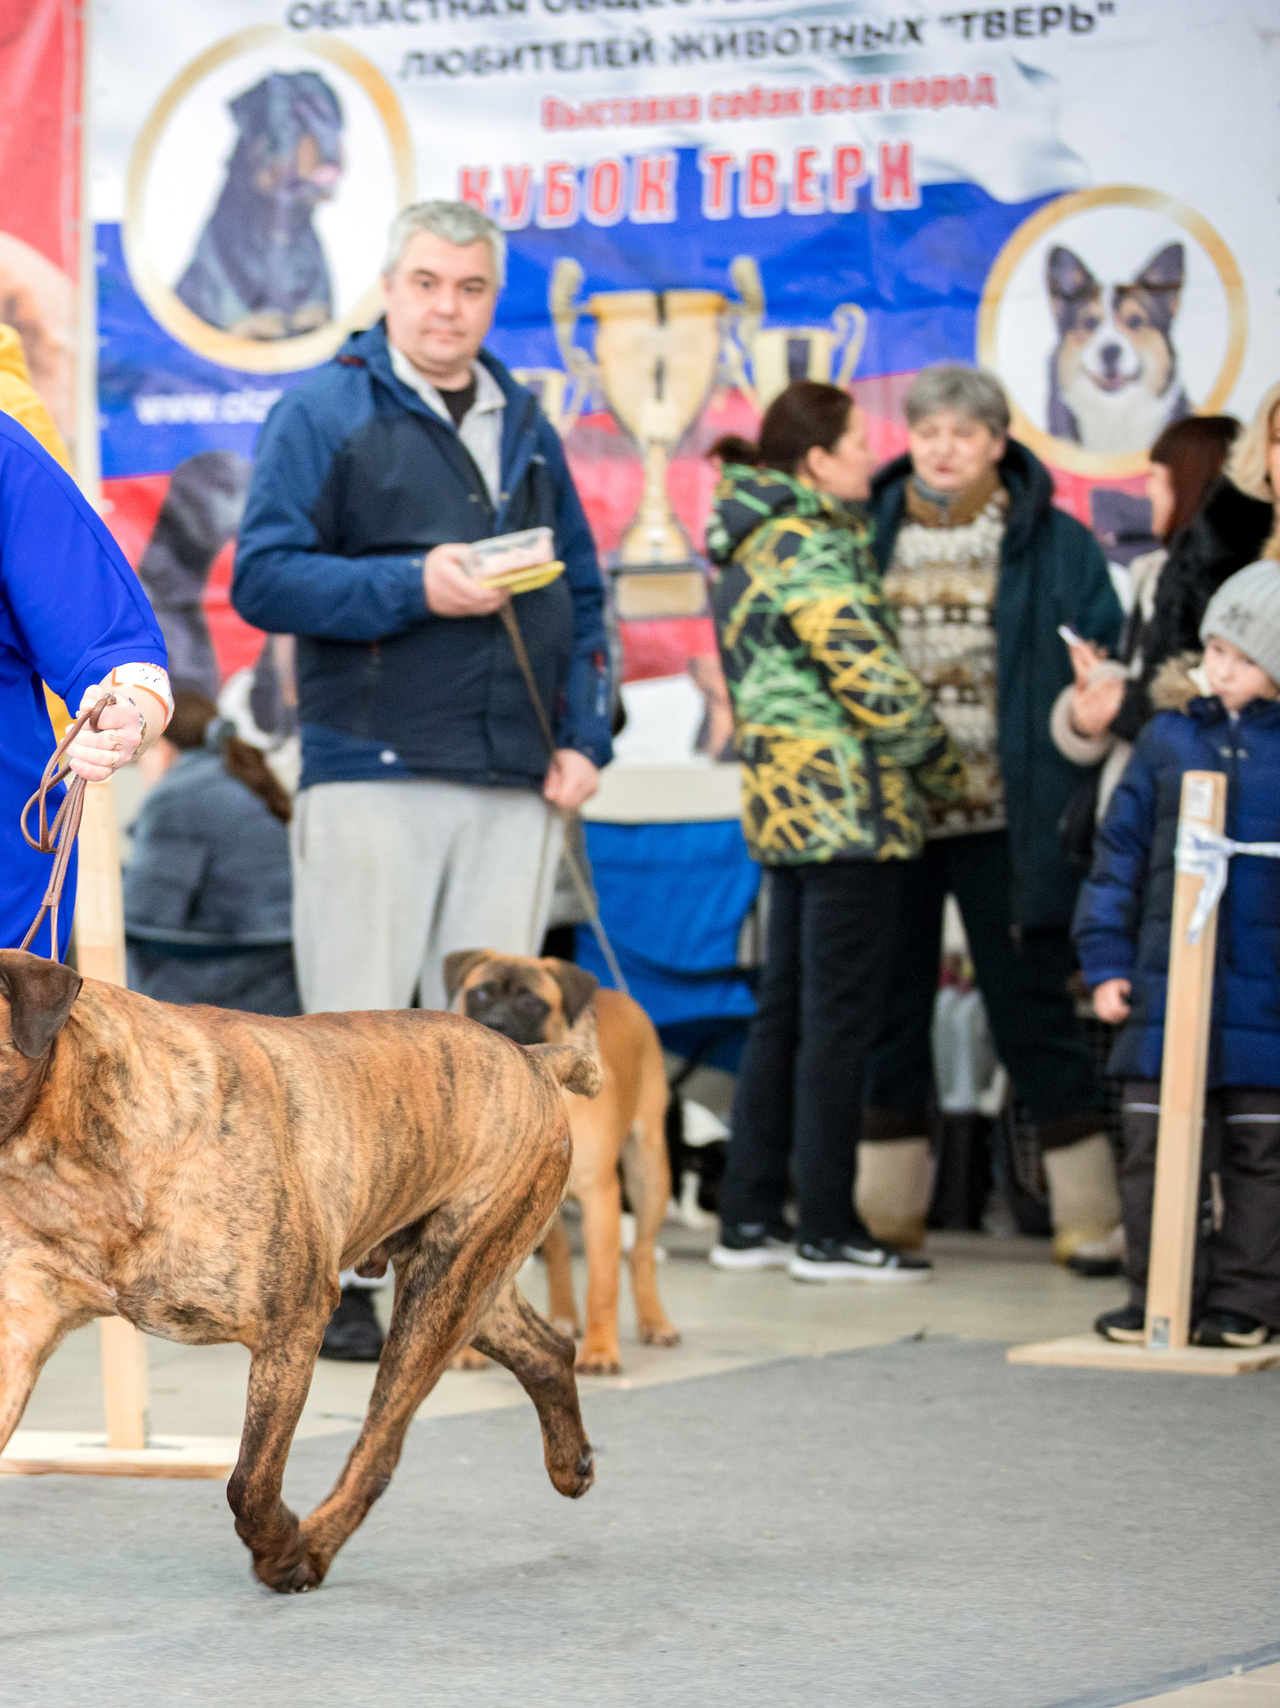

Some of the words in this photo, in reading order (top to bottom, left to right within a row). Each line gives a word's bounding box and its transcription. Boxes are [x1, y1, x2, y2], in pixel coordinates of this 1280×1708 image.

[398, 28, 656, 80] ЛЮБИТЕЛЕЙ
[668, 16, 925, 62] ЖИВОТНЫХ
[938, 1, 1116, 44] "ТВЕРЬ"
[541, 94, 701, 131] Выставка
[708, 84, 804, 121] собак
[809, 79, 884, 114] всех
[887, 72, 999, 110] пород
[457, 154, 680, 226] КУБОК
[701, 140, 922, 219] ТВЕРИ
